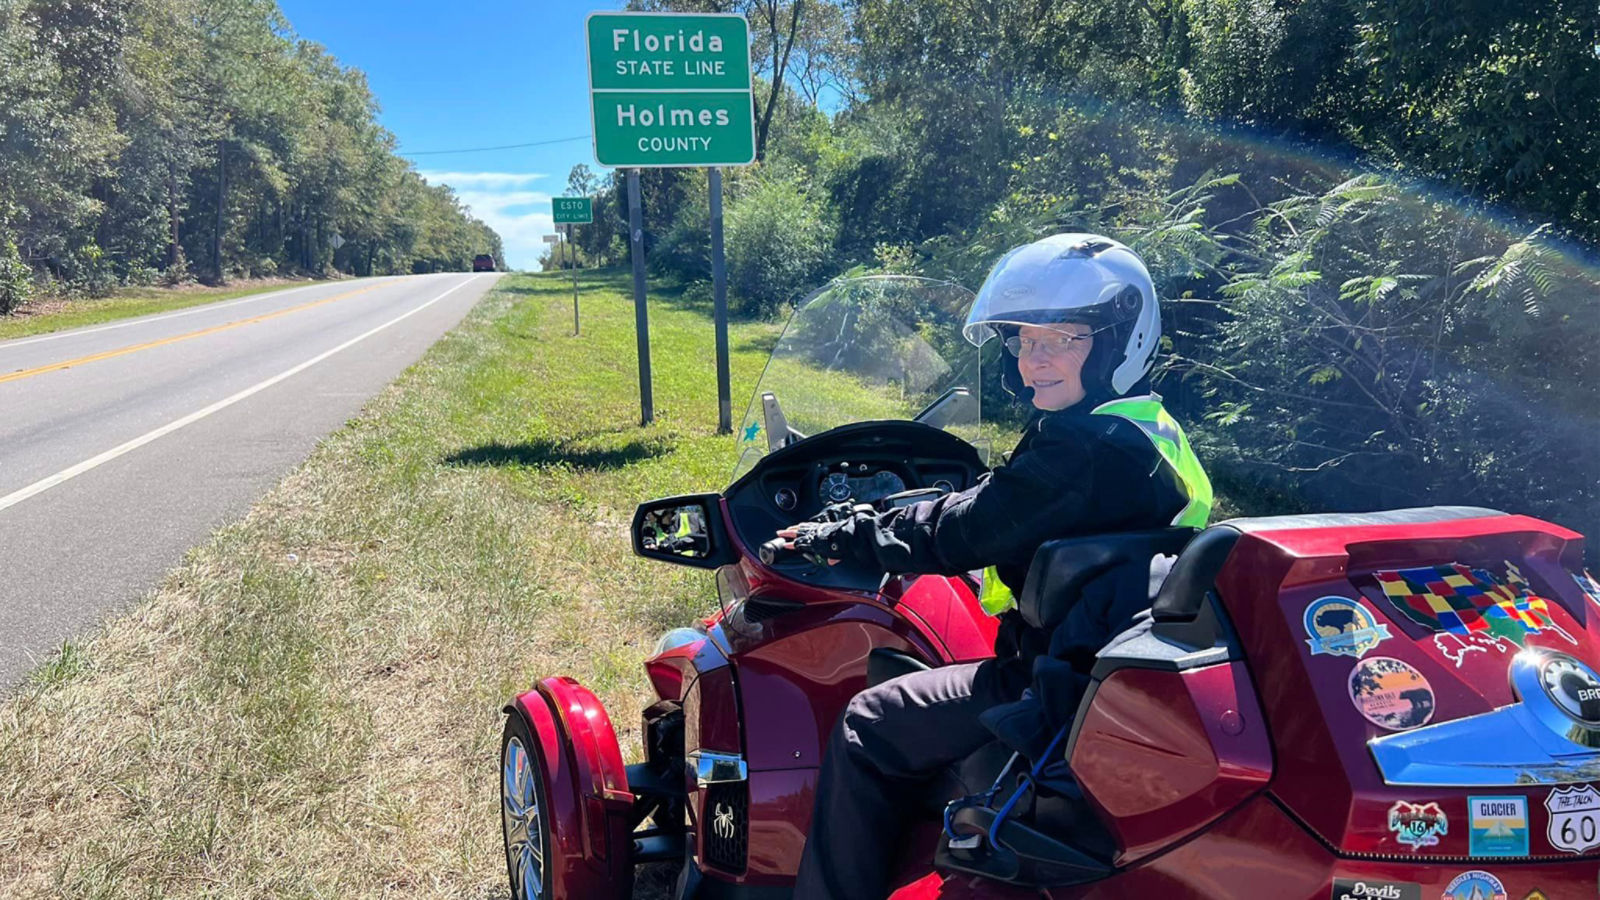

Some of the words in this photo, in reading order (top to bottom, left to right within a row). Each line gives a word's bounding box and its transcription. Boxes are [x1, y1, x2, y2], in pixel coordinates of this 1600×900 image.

[613, 29, 723, 52] Florida
[616, 61, 674, 75] STATE
[685, 61, 725, 75] LINE
[617, 104, 729, 126] Holmes
[638, 137, 712, 152] COUNTY
[560, 201, 583, 210] ESTO
[1557, 795, 1573, 809] THE
[1481, 803, 1516, 816] GLACIER
[1412, 821, 1424, 833] 16
[1561, 815, 1596, 845] 60
[1352, 882, 1401, 899] Devils
